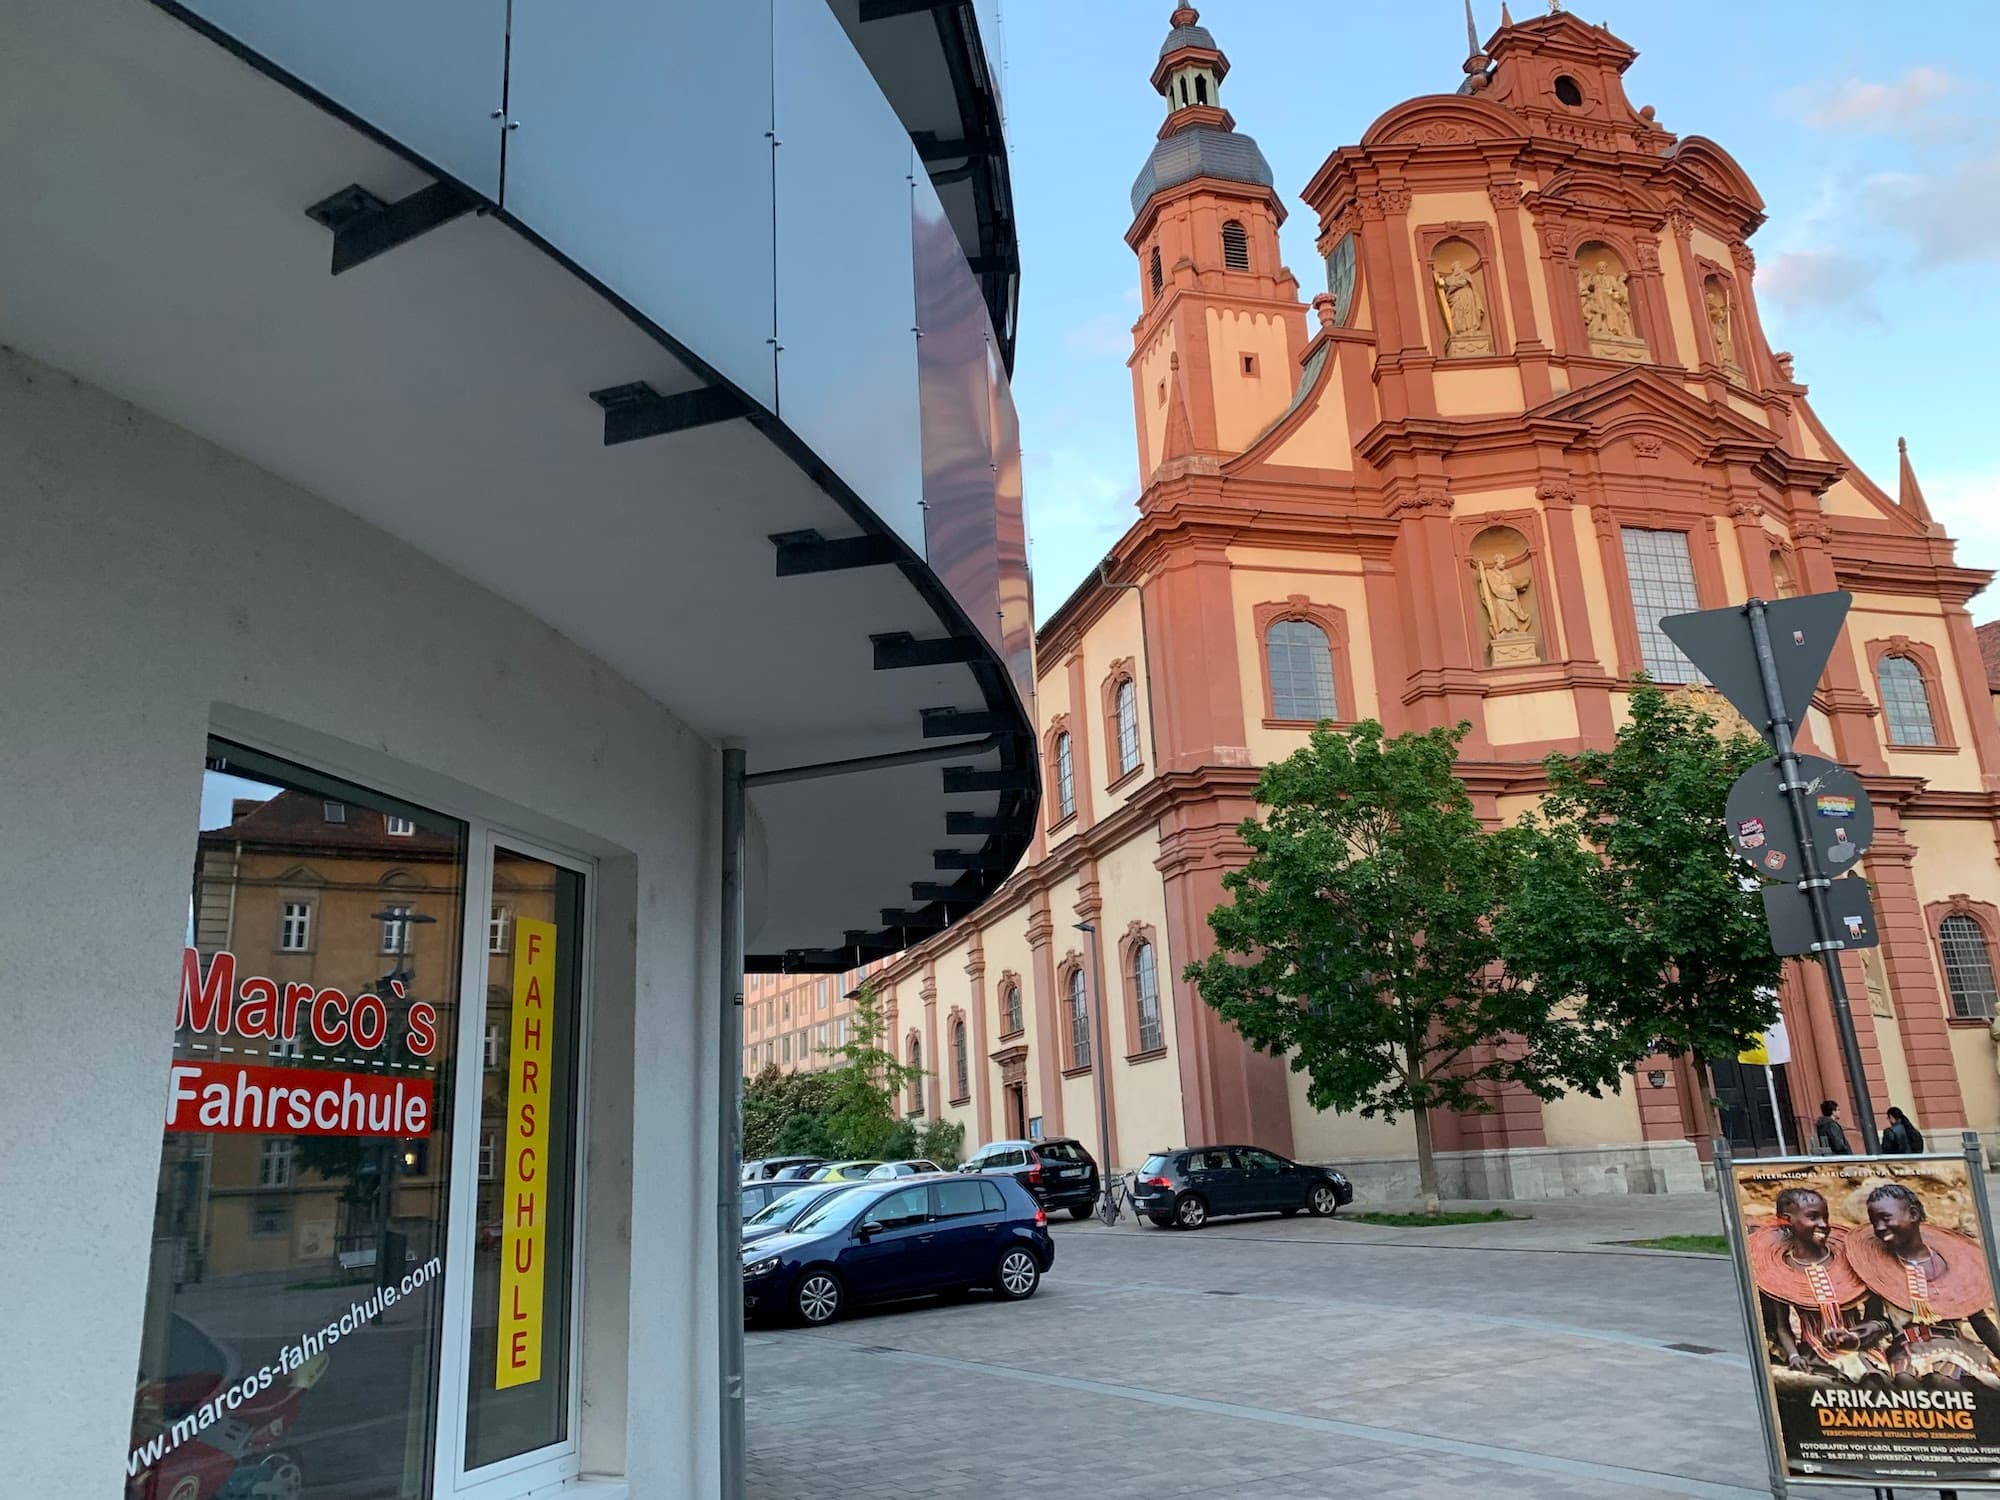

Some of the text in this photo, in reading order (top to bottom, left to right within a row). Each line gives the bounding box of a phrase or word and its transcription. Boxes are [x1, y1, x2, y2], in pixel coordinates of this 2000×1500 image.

[166, 1067, 427, 1132] Fahrschule
[512, 934, 542, 1368] FAHRSCHULE
[1753, 1171, 1817, 1180] INTERNATIONAL
[1810, 1389, 1976, 1410] AFRIKANISCHE
[1818, 1408, 1974, 1430] DÄMMERUNG
[1800, 1442, 1849, 1451] FOTOGRAFIEN
[1868, 1444, 1891, 1452] CAROL
[1949, 1446, 1979, 1454] ANGELA
